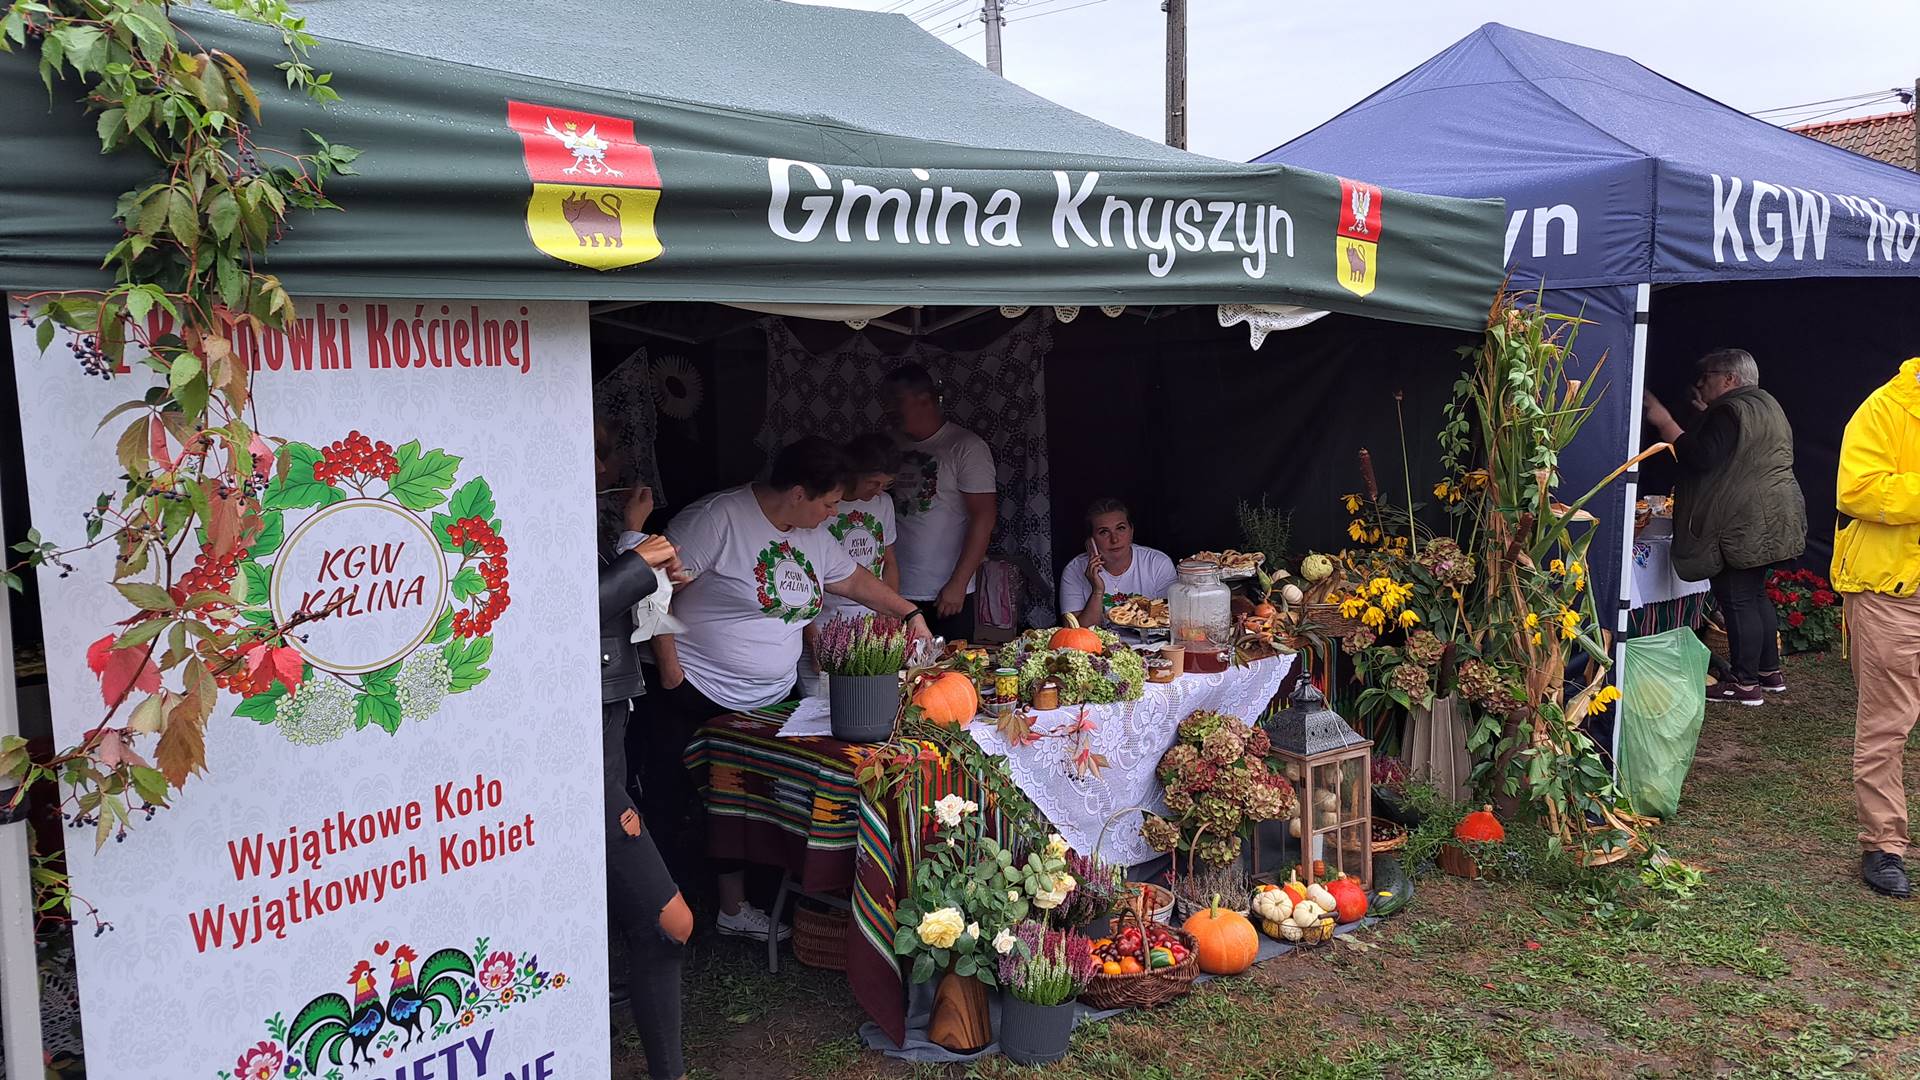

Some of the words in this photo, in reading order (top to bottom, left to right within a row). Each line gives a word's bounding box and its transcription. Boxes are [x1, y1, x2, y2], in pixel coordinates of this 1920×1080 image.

[767, 157, 1022, 248] Gmina
[1051, 170, 1295, 279] Knyszyn
[1711, 173, 1831, 263] KGW
[365, 304, 531, 374] Kościelnej
[317, 541, 405, 583] KGW
[849, 546, 873, 557] KALINA
[852, 537, 868, 547] KGW
[300, 575, 425, 622] KALINA
[780, 580, 809, 592] KALINA
[784, 570, 802, 581] KGW
[227, 800, 422, 881] Wyjątkowe
[434, 773, 503, 823] Koło
[188, 846, 428, 954] Wyjątkowych
[439, 813, 536, 875] Kobiet
